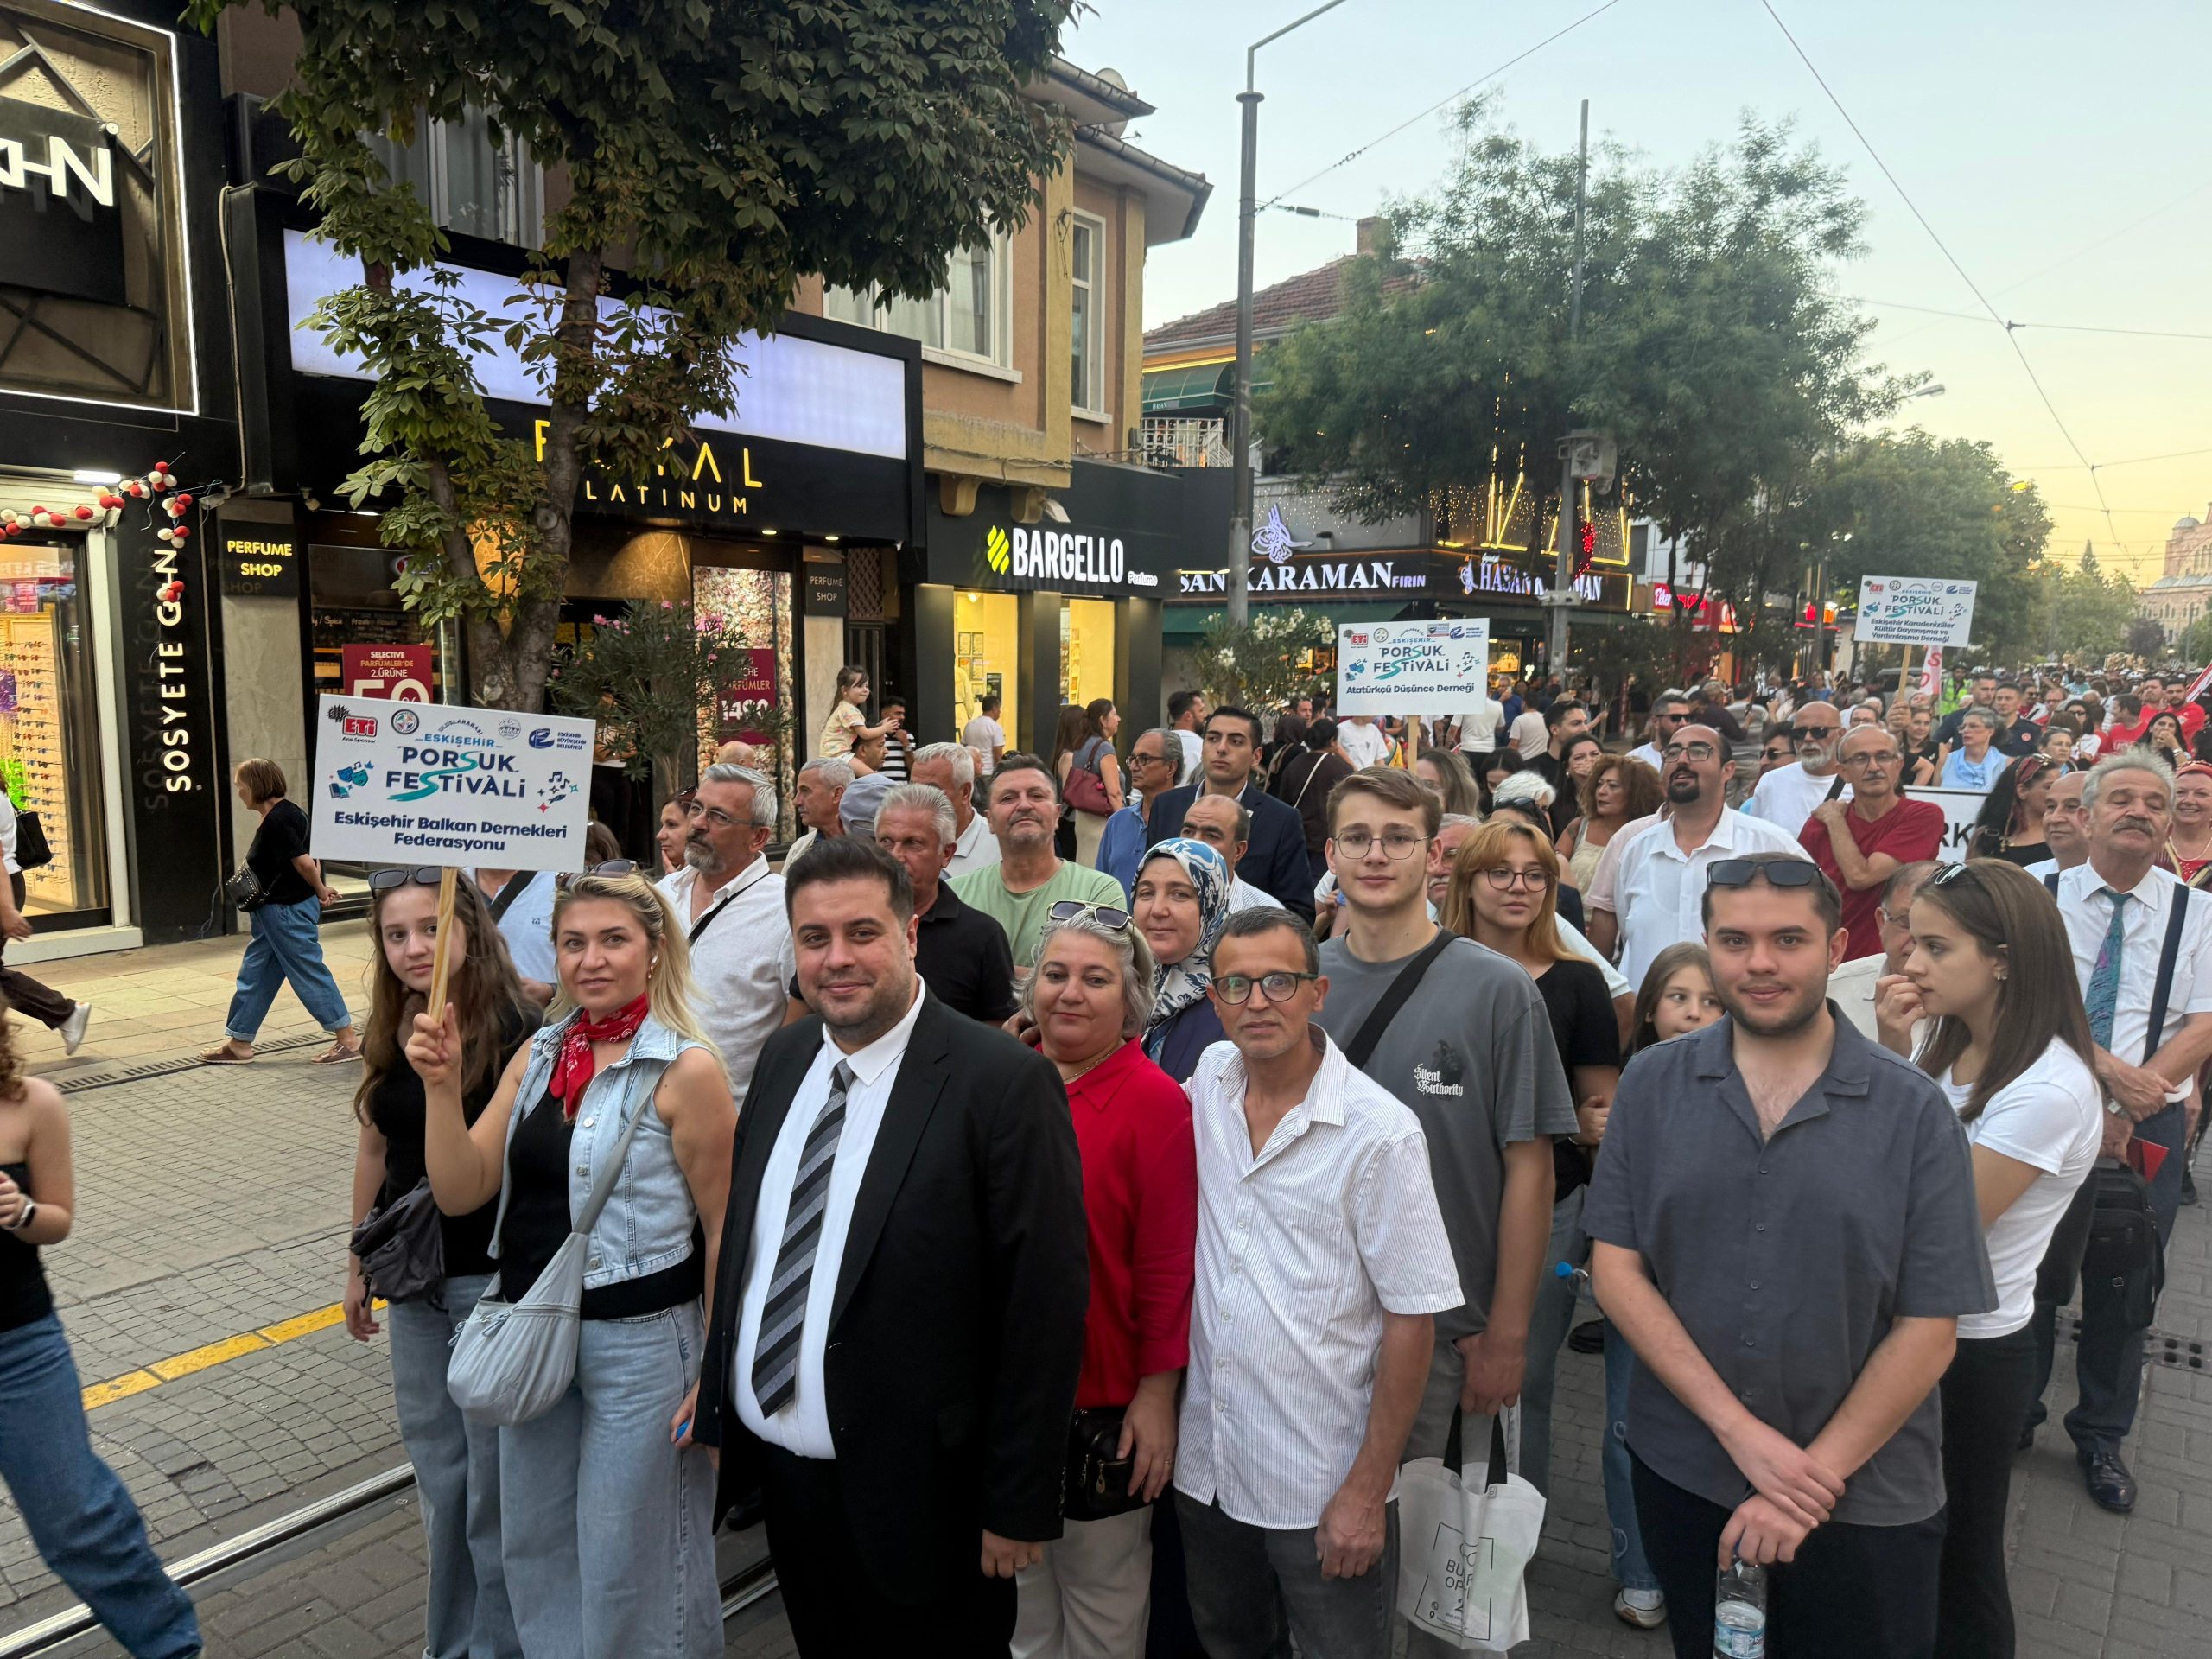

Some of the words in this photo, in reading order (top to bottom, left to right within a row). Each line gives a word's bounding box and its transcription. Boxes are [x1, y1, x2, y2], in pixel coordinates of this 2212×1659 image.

[586, 480, 747, 514] LATINUM
[227, 540, 293, 556] PERFUME
[1013, 528, 1124, 583] BARGELLO
[1128, 571, 1159, 586] Perfume
[240, 563, 283, 577] SHOP
[810, 576, 843, 587] PERFUME
[1392, 575, 1426, 588] FIRIN
[817, 593, 838, 601] SHOP
[1891, 594, 1941, 606] PORSUK
[1380, 645, 1445, 658] PORSUK
[1346, 685, 1391, 695] Atatürkçü
[1394, 684, 1434, 695] Düşünce
[1437, 683, 1474, 694] Derneği
[158, 642, 192, 791] SOSYETE
[398, 746, 518, 772] PORSUK
[334, 811, 415, 829] Eskişehir
[417, 817, 477, 832] Balkan
[480, 821, 568, 838] Dernekleri
[393, 832, 505, 851] Federasyonu
[1414, 1063, 1440, 1082] Silent
[1417, 1080, 1463, 1096] Authority
